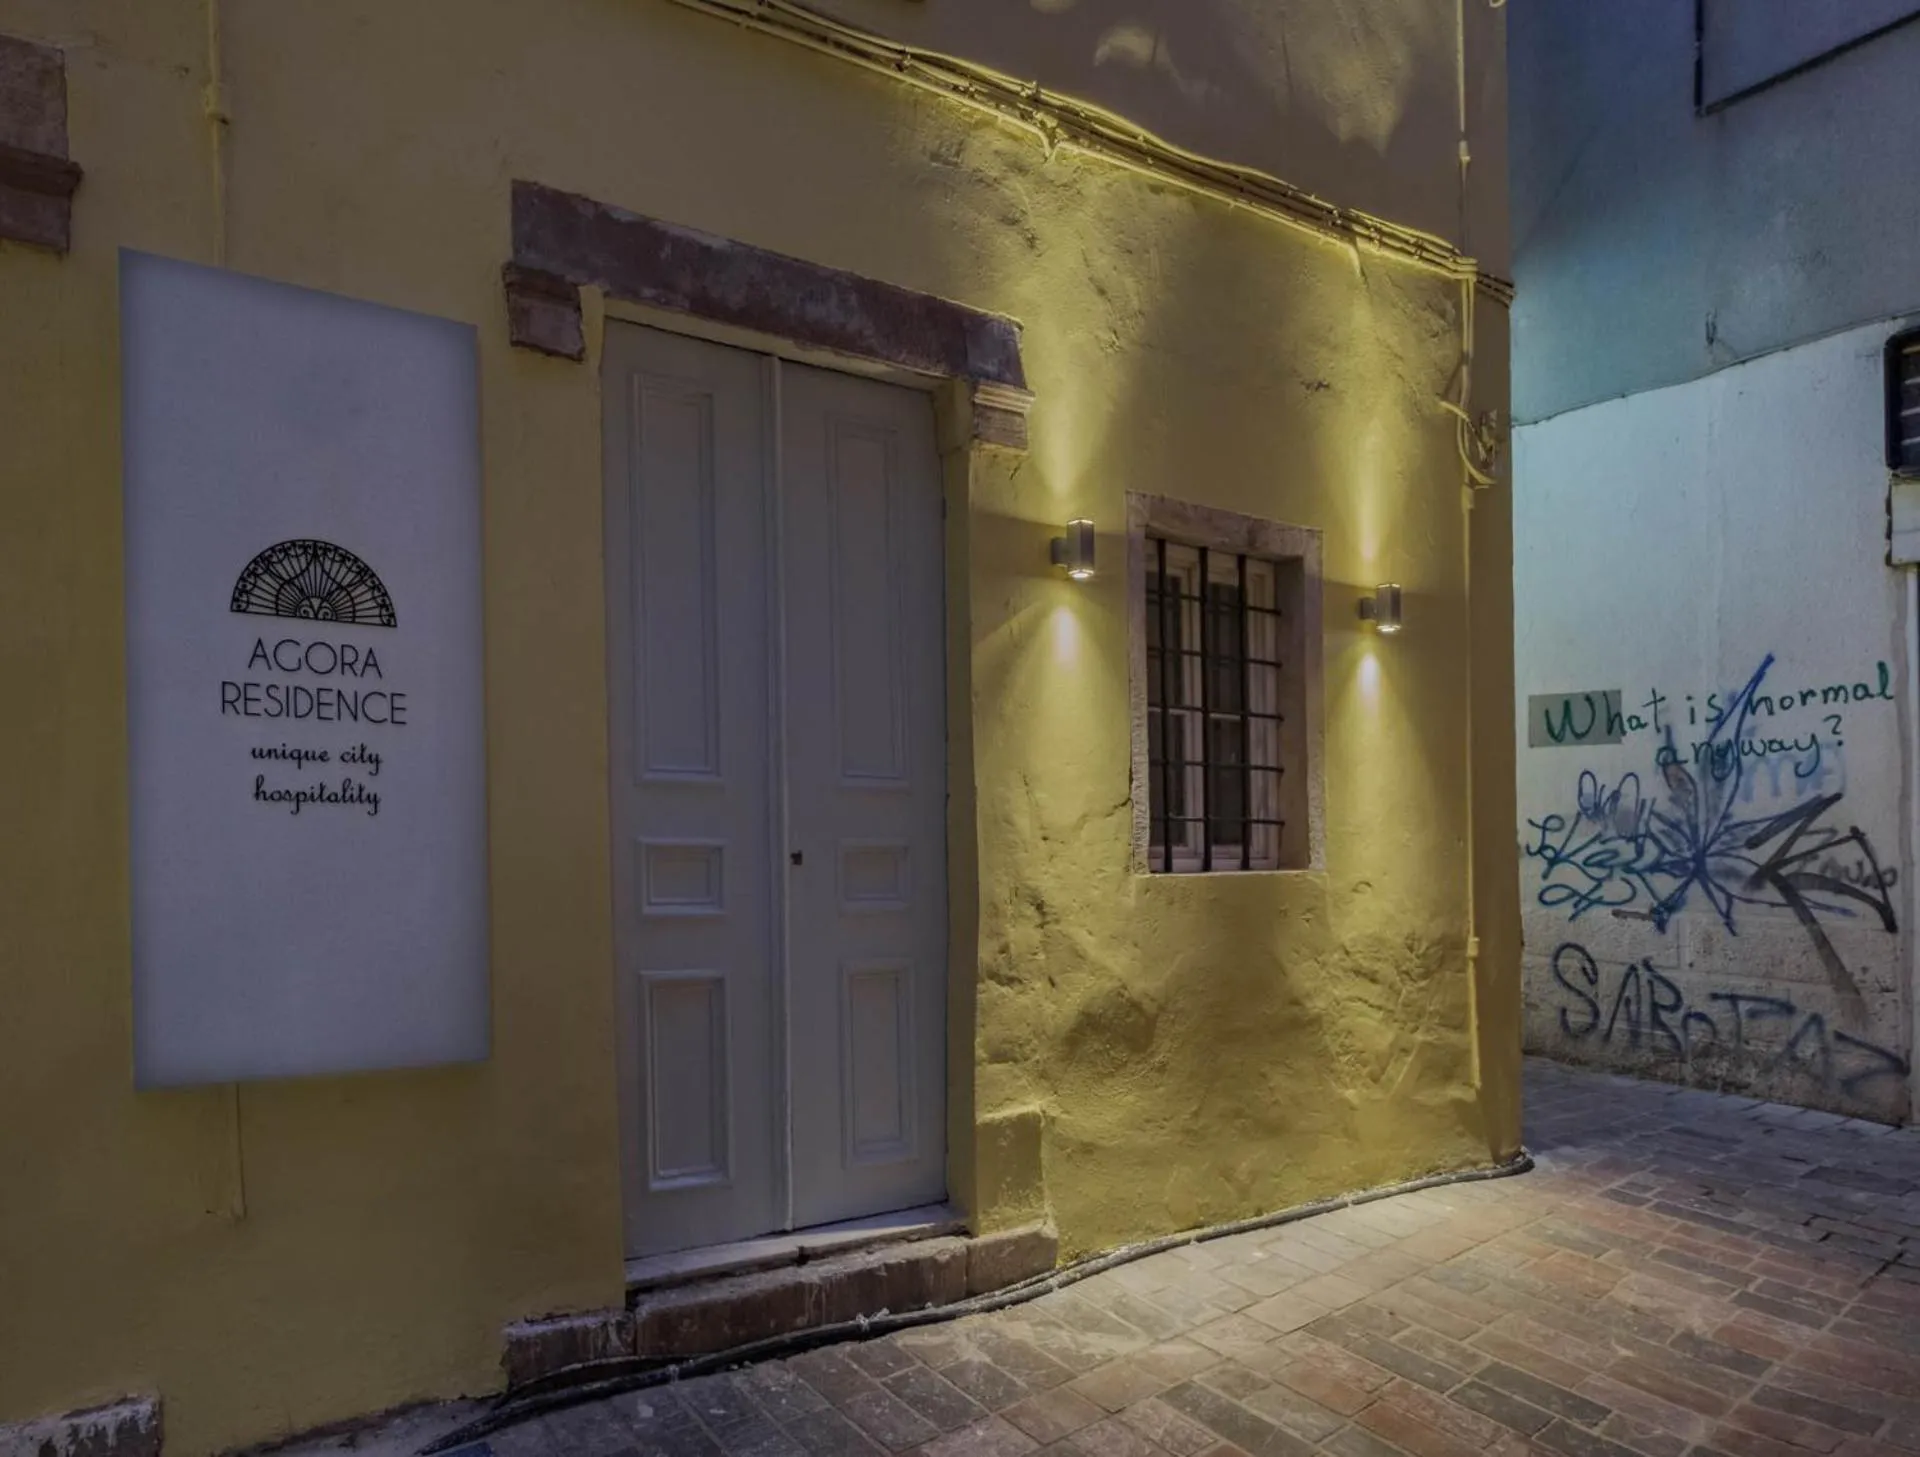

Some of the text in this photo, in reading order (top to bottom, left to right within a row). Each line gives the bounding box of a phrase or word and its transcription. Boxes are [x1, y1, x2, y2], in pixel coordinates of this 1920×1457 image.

[248, 637, 383, 677] AGORA
[221, 681, 407, 725] RESIDENCE
[1545, 661, 1894, 744] What is normal
[251, 743, 383, 776] unique city
[254, 775, 381, 816] hospitality
